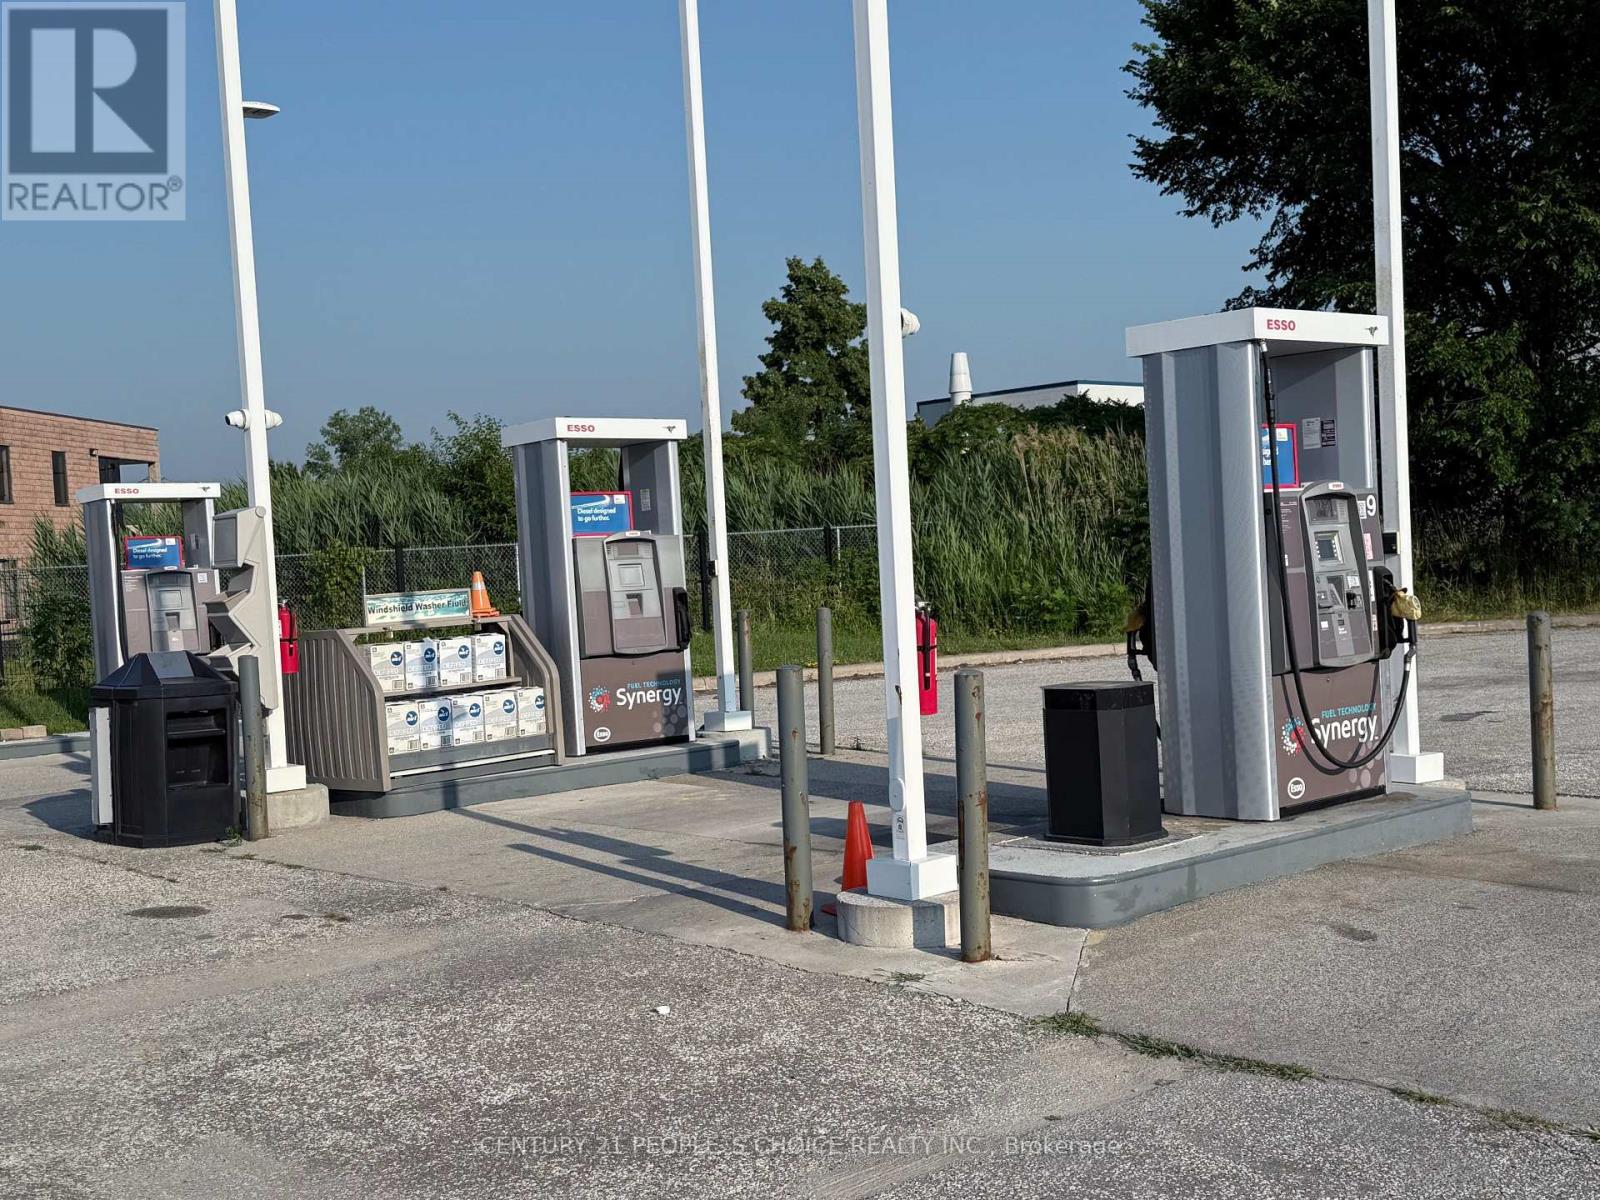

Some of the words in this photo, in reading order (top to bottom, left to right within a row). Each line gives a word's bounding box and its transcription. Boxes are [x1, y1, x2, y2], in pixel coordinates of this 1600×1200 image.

[1266, 319, 1296, 331] ESSO
[566, 424, 596, 433] ESSO
[113, 487, 140, 495] ESSO
[593, 507, 616, 516] designed
[1366, 494, 1377, 517] 9
[368, 603, 413, 615] Windshield
[414, 602, 445, 611] Washer
[446, 599, 467, 608] Fluid
[643, 678, 681, 688] TECHNOLOGY
[616, 687, 682, 710] Synergy
[1321, 709, 1337, 719] FUEL
[1338, 702, 1377, 716] TECHNOLOGY
[1310, 715, 1378, 749] Synergy
